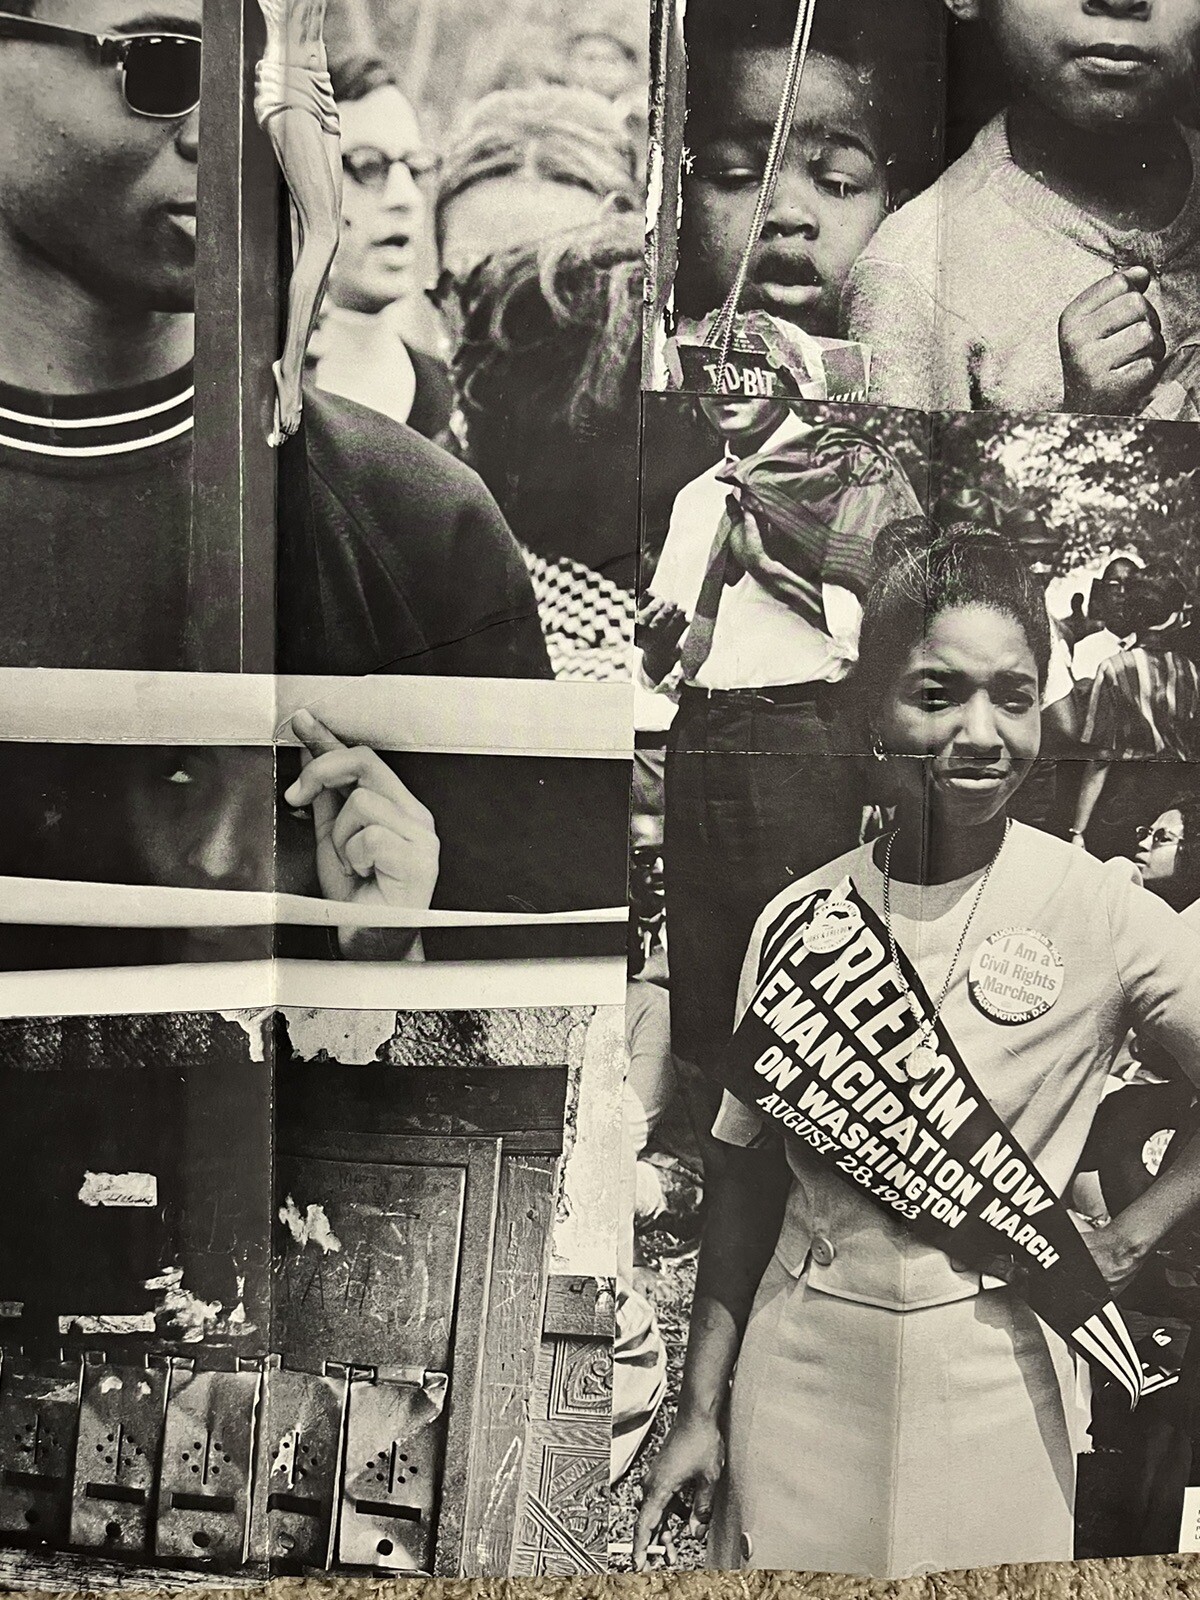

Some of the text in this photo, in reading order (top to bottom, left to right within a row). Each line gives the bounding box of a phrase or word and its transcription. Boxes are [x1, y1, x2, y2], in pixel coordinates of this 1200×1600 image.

[979, 953, 1056, 991] Civil Rights
[1003, 938, 1051, 967] I Am a
[982, 975, 1043, 1006] Marcher
[752, 968, 1060, 1270] EMANCIPATION MARCH
[753, 1045, 968, 1229] ON WASHINGTON
[756, 1092, 842, 1155] AUGUST
[969, 1131, 1055, 1217] NOW
